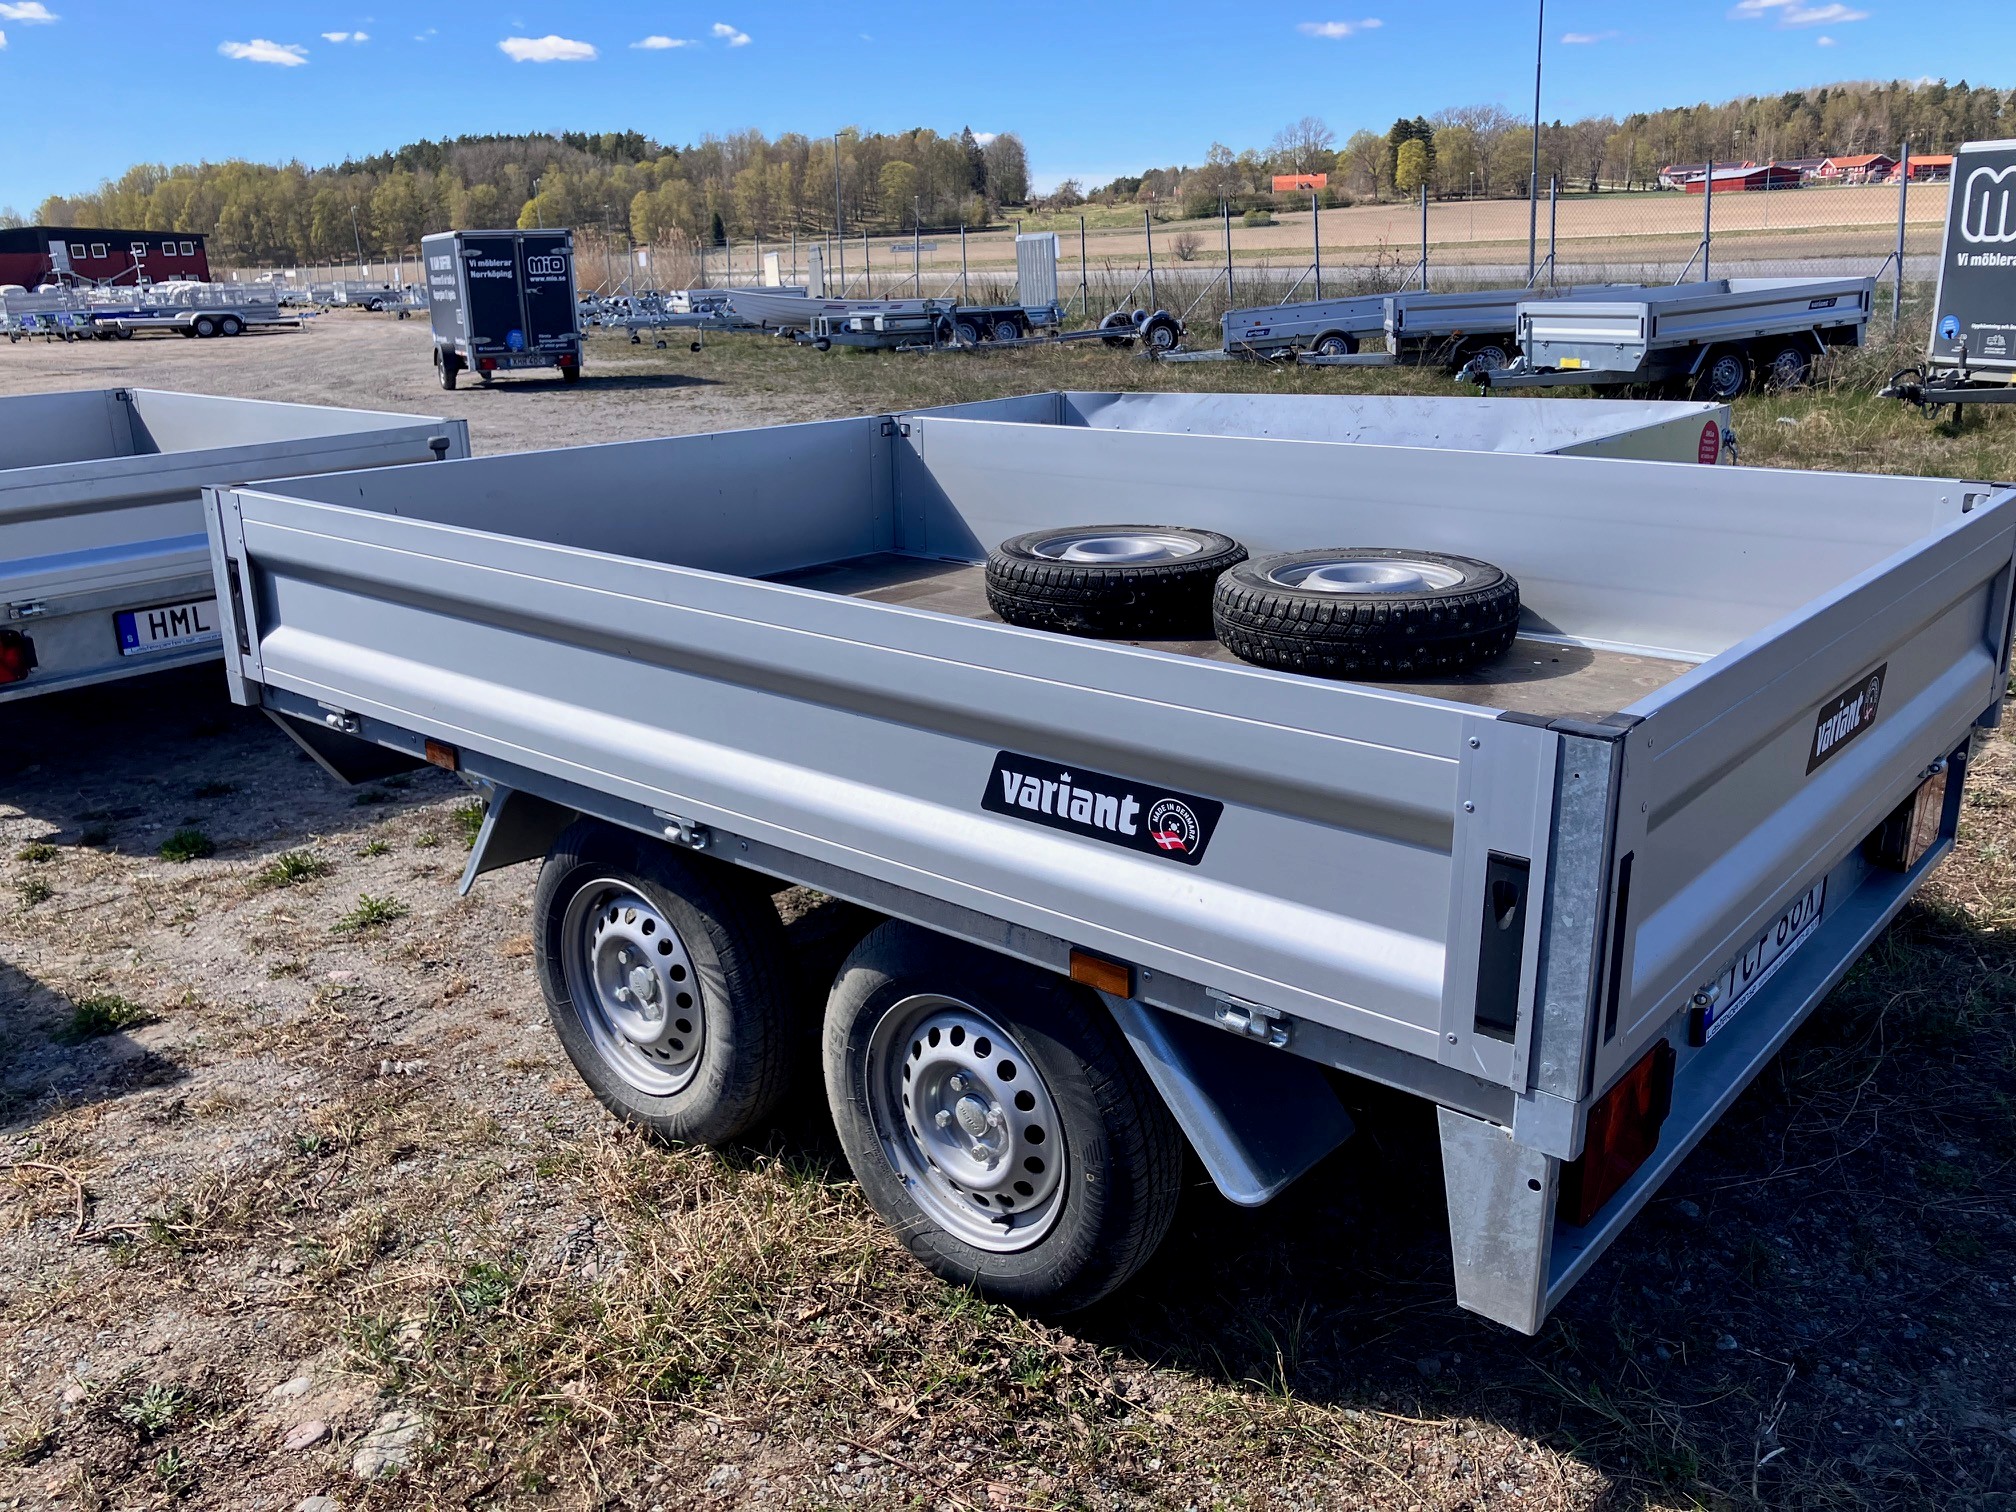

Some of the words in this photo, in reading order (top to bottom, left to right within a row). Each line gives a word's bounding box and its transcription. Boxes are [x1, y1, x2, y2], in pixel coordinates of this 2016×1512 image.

[469, 259, 477, 267] Vi
[478, 259, 512, 267] möblerar
[470, 270, 513, 279] Norrköping
[1957, 252, 1969, 267] Vi
[149, 606, 211, 640] HML
[1816, 691, 1864, 757] variant
[1001, 769, 1141, 836] variant
[1152, 804, 1167, 823] MADE
[1166, 803, 1175, 811] IN
[1175, 805, 1196, 841] DENMARK
